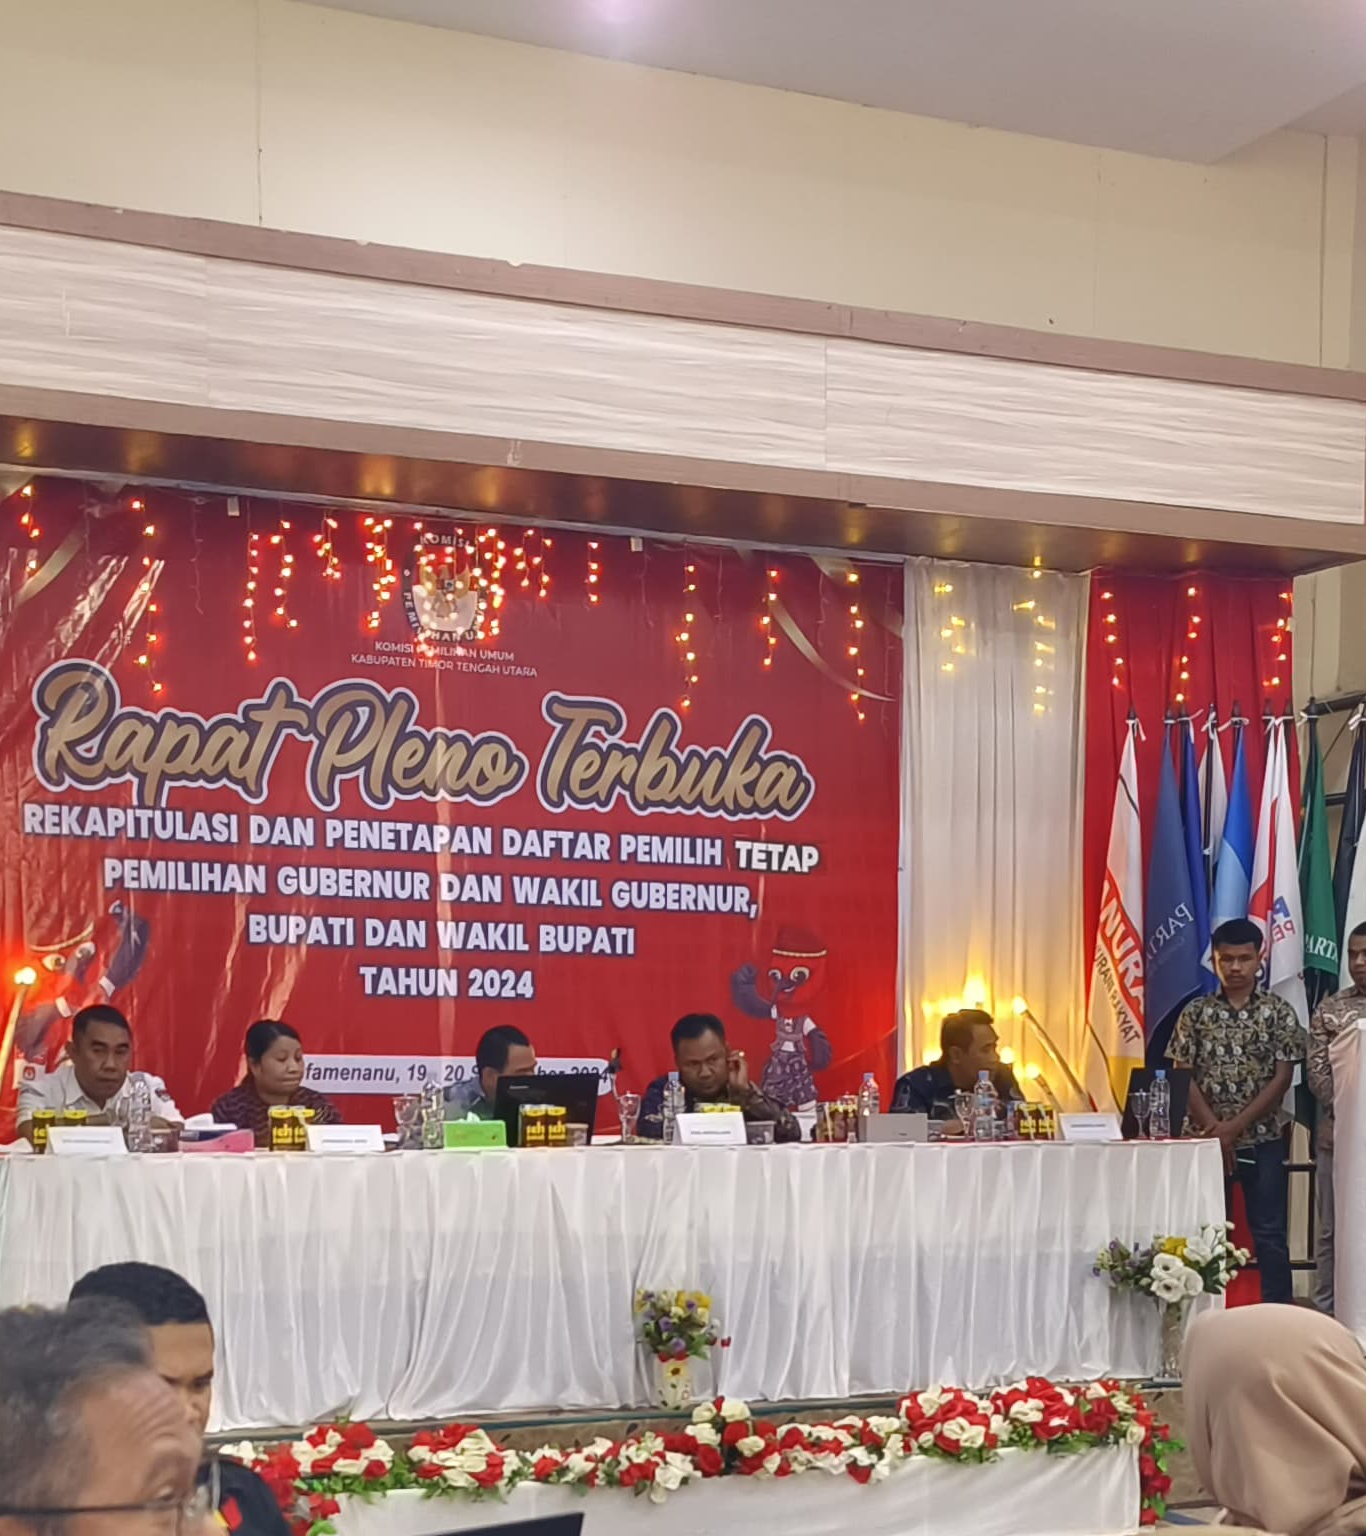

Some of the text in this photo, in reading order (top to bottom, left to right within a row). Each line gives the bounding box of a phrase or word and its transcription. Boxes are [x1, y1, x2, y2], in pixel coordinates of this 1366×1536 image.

[351, 653, 538, 678] KABUPATEN TIMOR TENGAH UTARA
[375, 641, 414, 654] KOMISI
[480, 650, 515, 662] UMUM
[37, 662, 811, 816] Rapat Pleno Terbuka
[23, 804, 820, 873] REKAPITULASI DAN PENETAPAN DAFTAR PEMILIH TETAP
[104, 858, 758, 919] PEMILIHAN GUBERNUR DAN WAKIL GUBERNUR,
[248, 914, 635, 955] BUPATI DAN WAKIL BUPATI
[360, 966, 534, 999] TAHUN 2024
[305, 1062, 401, 1084] famenanu,
[407, 1064, 427, 1081] 19
[444, 1064, 465, 1082] 20
